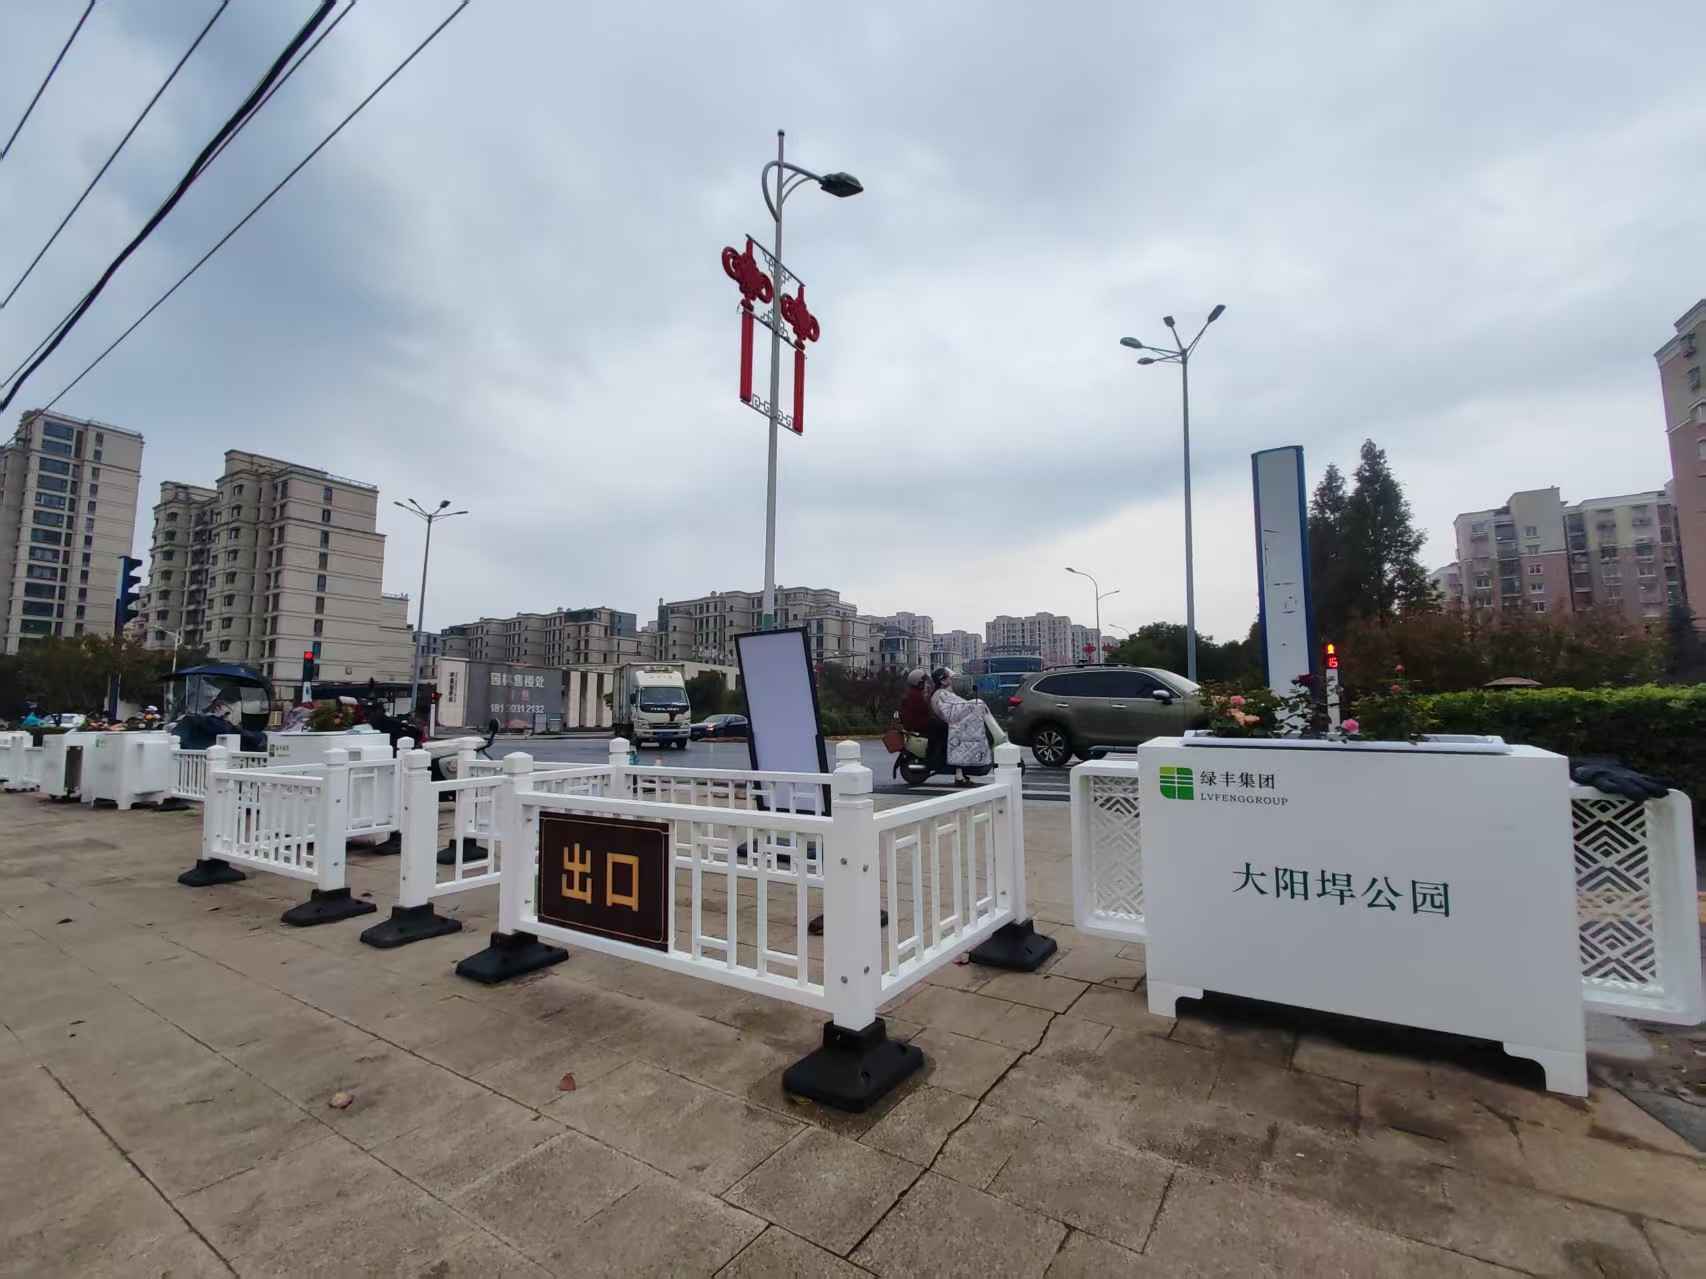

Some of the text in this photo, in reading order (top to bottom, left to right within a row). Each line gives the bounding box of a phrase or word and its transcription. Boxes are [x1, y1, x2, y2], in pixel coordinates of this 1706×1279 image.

[1200, 770, 1275, 790] 绿丰集团
[1200, 793, 1289, 806] LVFENGGROUP
[561, 842, 639, 912] 出口
